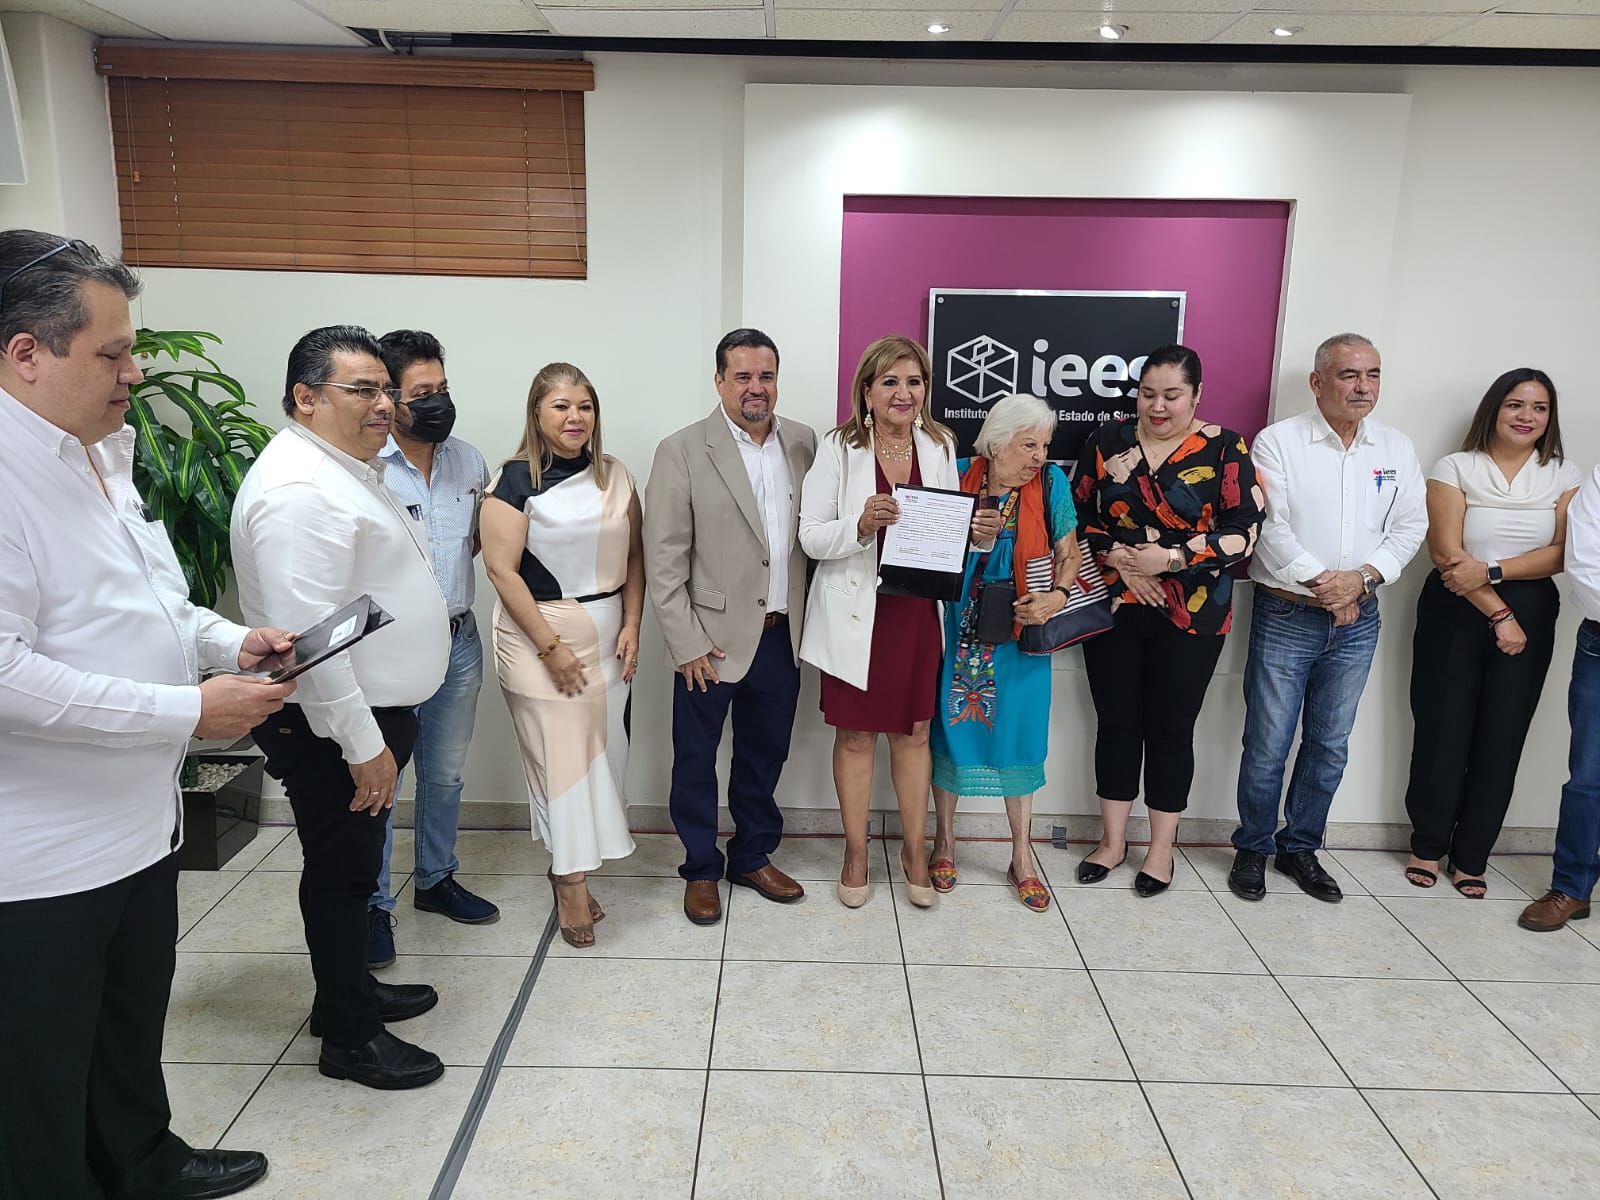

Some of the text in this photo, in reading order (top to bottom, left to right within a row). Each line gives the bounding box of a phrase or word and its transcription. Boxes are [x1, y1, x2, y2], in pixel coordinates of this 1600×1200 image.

[944, 407, 988, 419] Instituto
[1059, 409, 1095, 422] Estado
[1097, 410, 1111, 422] de
